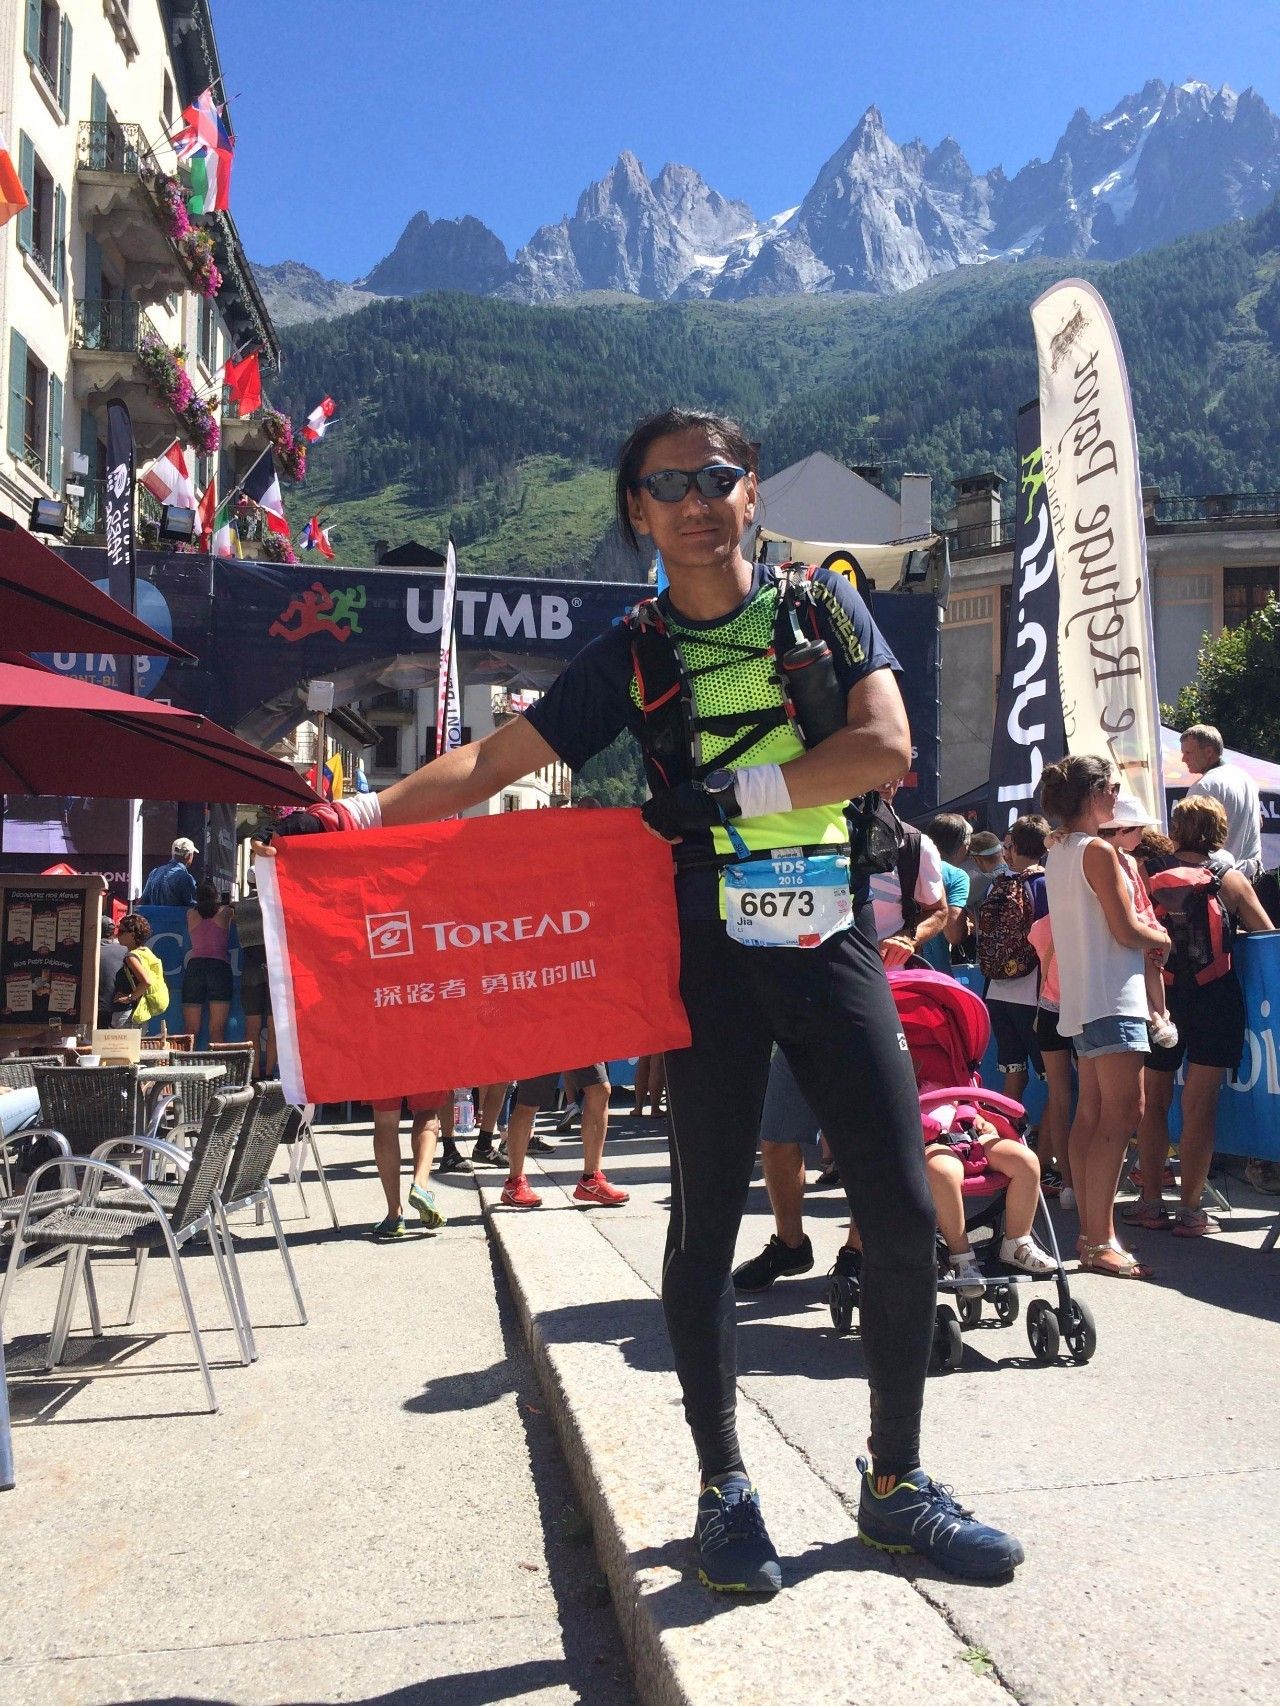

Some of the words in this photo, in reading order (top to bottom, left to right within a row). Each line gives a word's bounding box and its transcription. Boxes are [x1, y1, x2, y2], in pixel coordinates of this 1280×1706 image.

[771, 860, 807, 875] TDS
[778, 876, 804, 886] 2016
[740, 890, 815, 918] 6673
[736, 917, 753, 926] Jia
[373, 978, 467, 1008] 探路者
[480, 958, 597, 995] 勇敢的心
